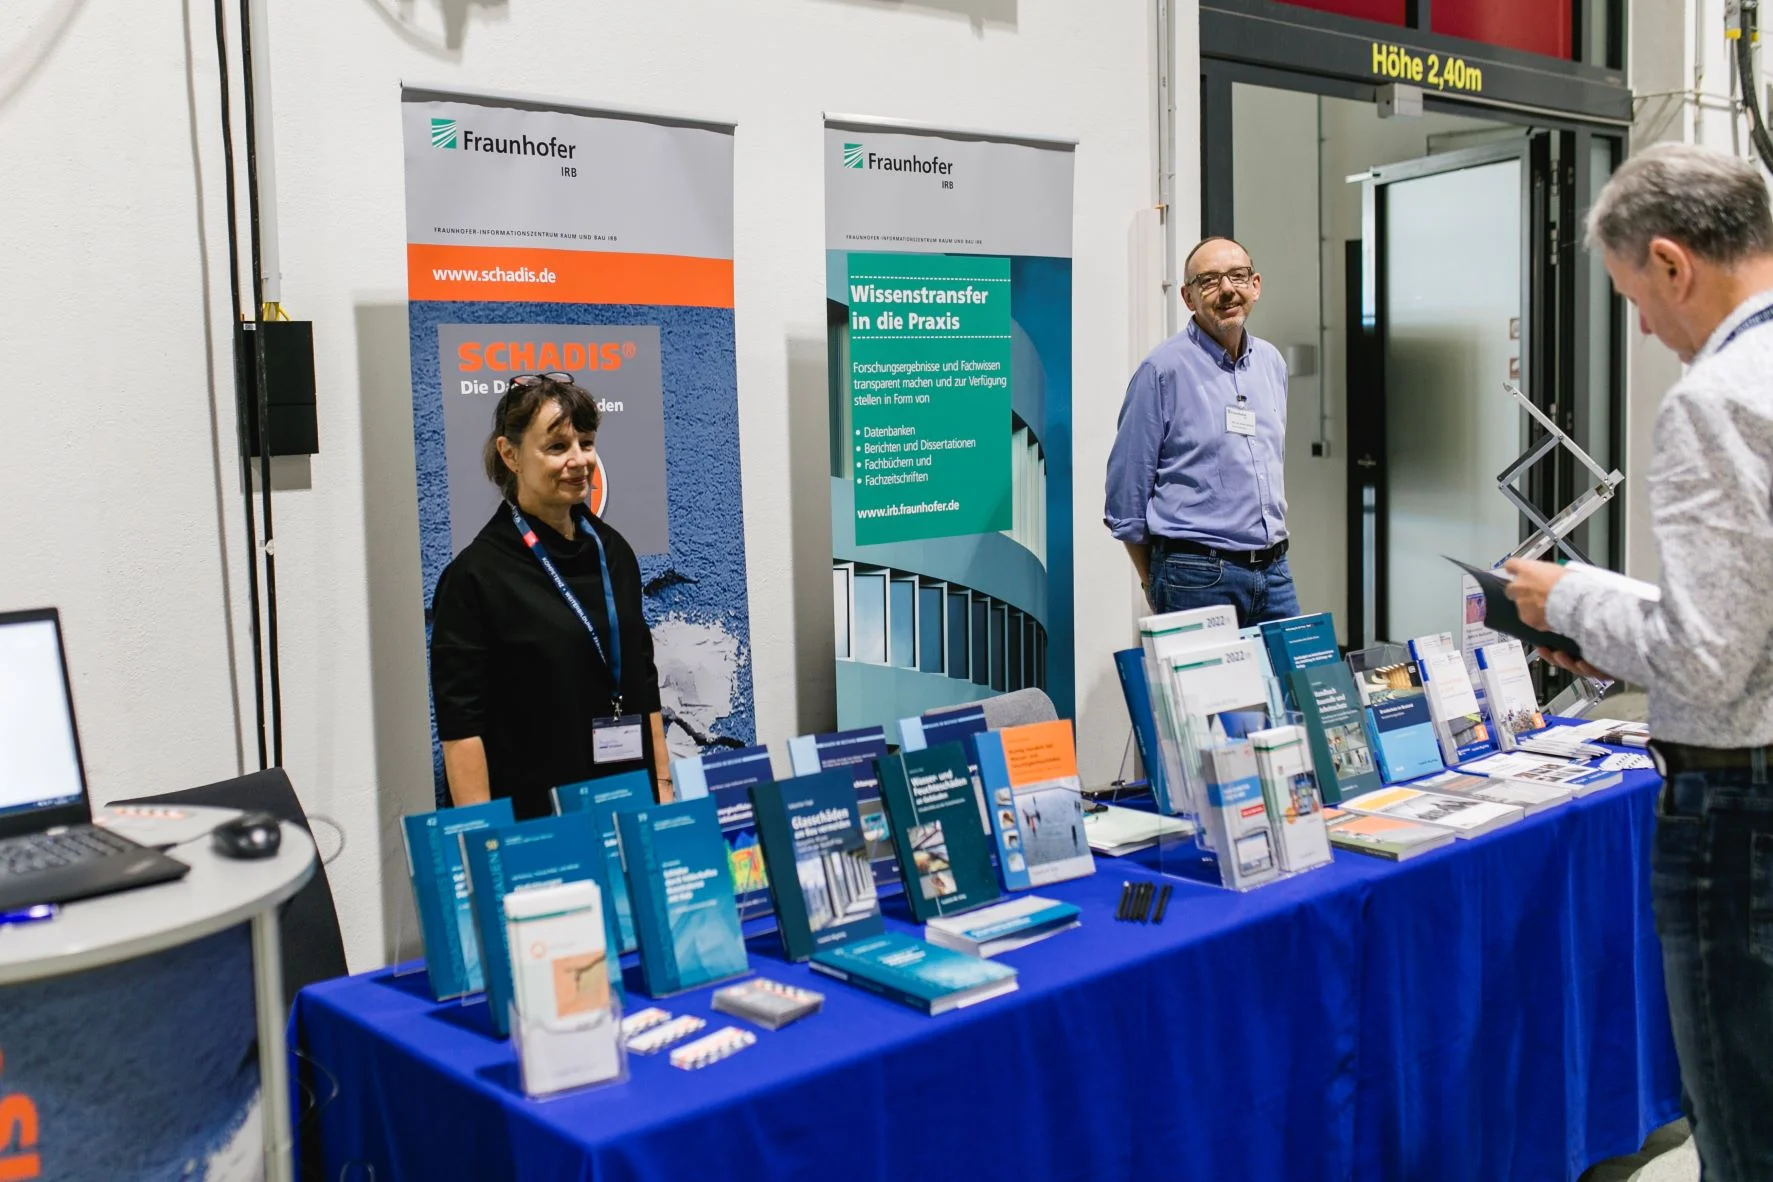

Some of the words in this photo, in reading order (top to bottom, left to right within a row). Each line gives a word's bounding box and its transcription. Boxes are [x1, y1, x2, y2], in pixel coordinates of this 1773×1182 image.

[1372, 42, 1423, 81] Höhe
[1427, 54, 1482, 92] 2,40m
[464, 130, 576, 159] Fraunhofer
[868, 152, 953, 175] Fraunhofer
[561, 166, 577, 178] IRB
[942, 180, 954, 190] IRB
[434, 226, 559, 238] FRAUNHOFER-INFORMATIONSZENTRUM
[560, 232, 577, 240] RAUM
[432, 266, 557, 284] www.schadis.de
[850, 285, 989, 304] Wissenstransfer
[852, 311, 870, 330] in
[876, 311, 903, 330] die
[908, 312, 960, 331] Praxis
[853, 361, 940, 375] Forschungsergebnisse
[942, 360, 958, 371] und
[961, 359, 1000, 371] Fachwissen
[461, 379, 489, 395] Die
[854, 377, 900, 391] transparent
[903, 376, 933, 388] machen
[936, 376, 951, 387] und
[954, 377, 966, 387] zur
[969, 375, 1007, 388] Verfügung
[854, 394, 881, 406] stellen
[884, 393, 891, 404] in
[894, 393, 913, 404] Form
[915, 394, 930, 404] von
[864, 425, 915, 438] Datenbanken
[864, 440, 900, 454] Berichten
[903, 440, 918, 451] und
[921, 438, 976, 451] Dissertationen
[864, 456, 913, 470] Fachbüchern
[916, 455, 932, 466] und
[865, 471, 928, 486] Fachzeitschriften
[857, 499, 960, 519] www.irb.fraunhofer.de
[1206, 615, 1225, 628] 2022
[1225, 650, 1245, 664] 2022
[791, 807, 850, 830] Glasschäden
